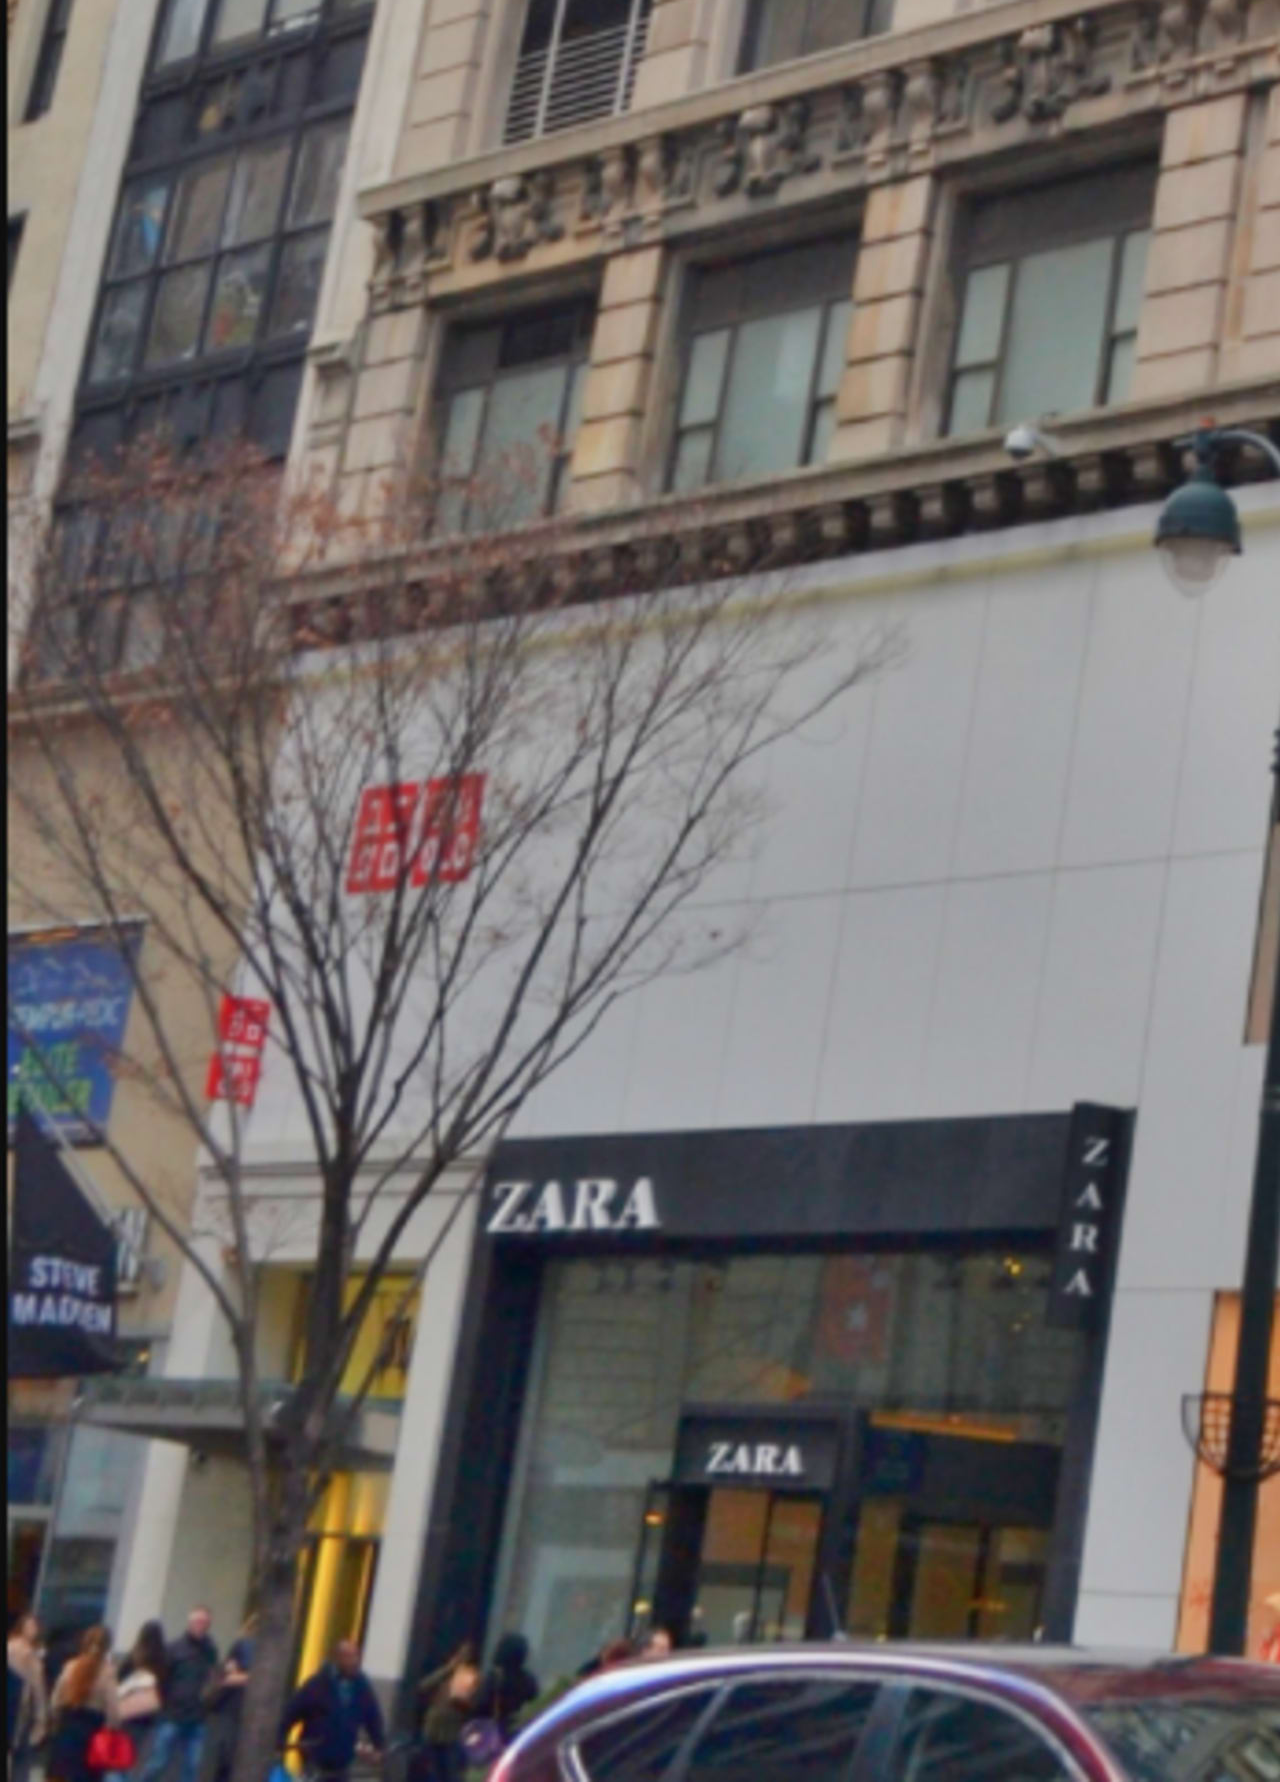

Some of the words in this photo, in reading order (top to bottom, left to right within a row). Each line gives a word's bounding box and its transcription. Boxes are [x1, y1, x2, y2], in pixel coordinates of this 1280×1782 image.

[486, 1176, 662, 1233] ZARA
[1064, 1137, 1110, 1298] ZARA
[705, 1441, 805, 1475] ZARA
